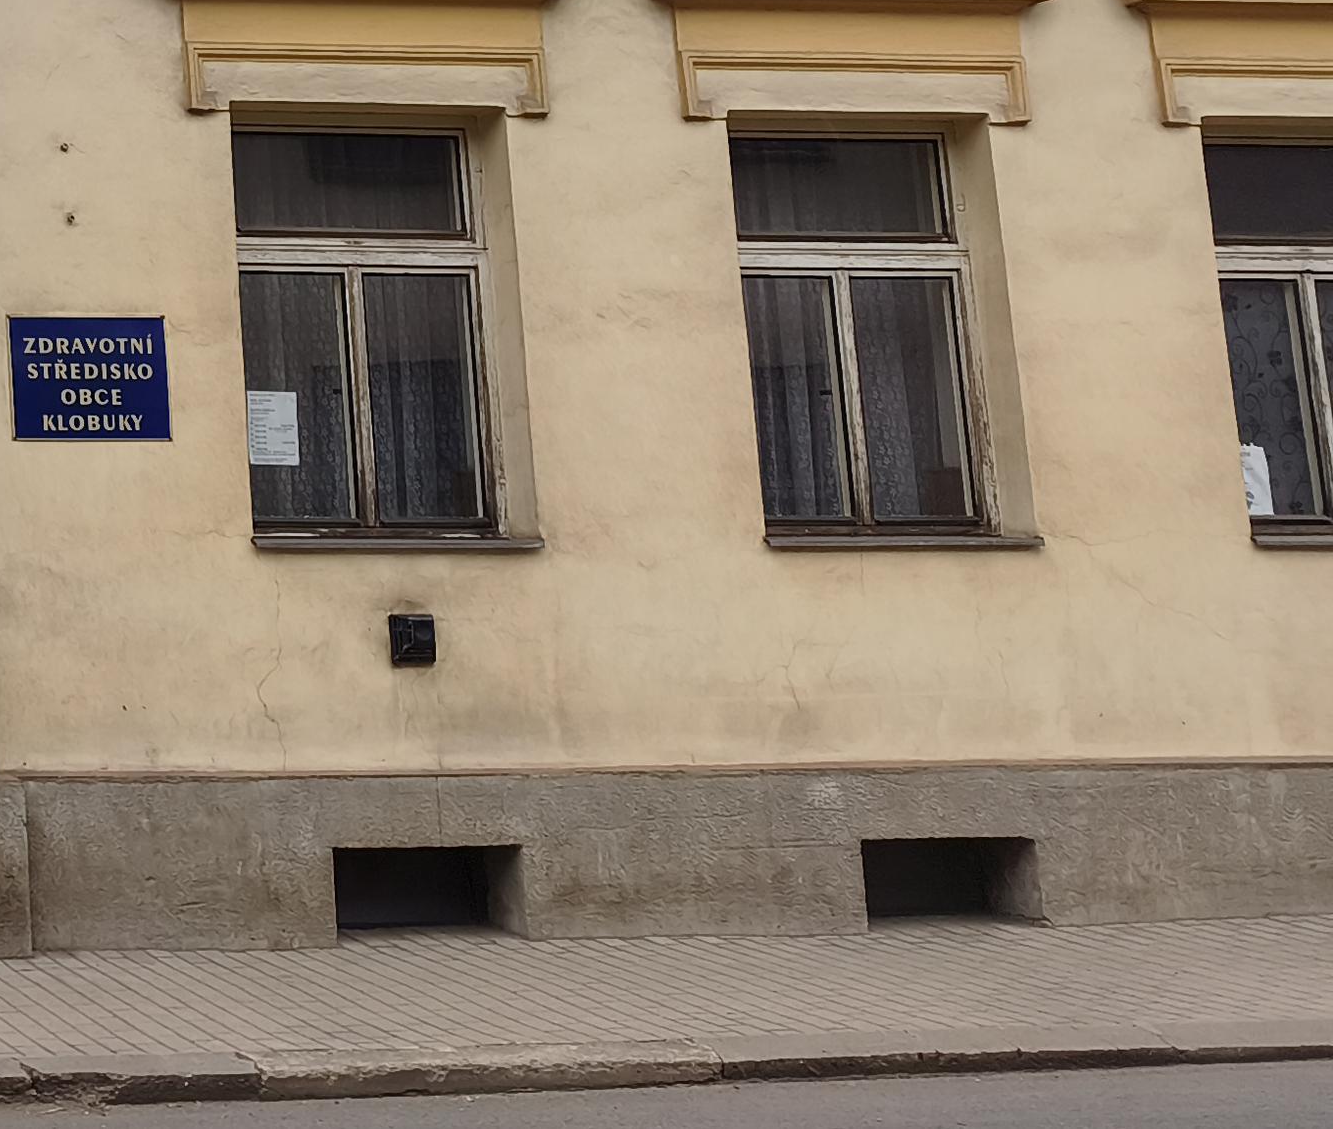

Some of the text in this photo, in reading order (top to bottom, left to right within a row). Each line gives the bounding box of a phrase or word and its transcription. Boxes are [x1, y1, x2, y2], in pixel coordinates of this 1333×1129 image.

[23, 334, 153, 354] ZDRAVOTNÍ
[27, 359, 153, 380] STŘEDISKO
[61, 388, 122, 406] OBCE
[42, 414, 143, 431] KLOBUKY
